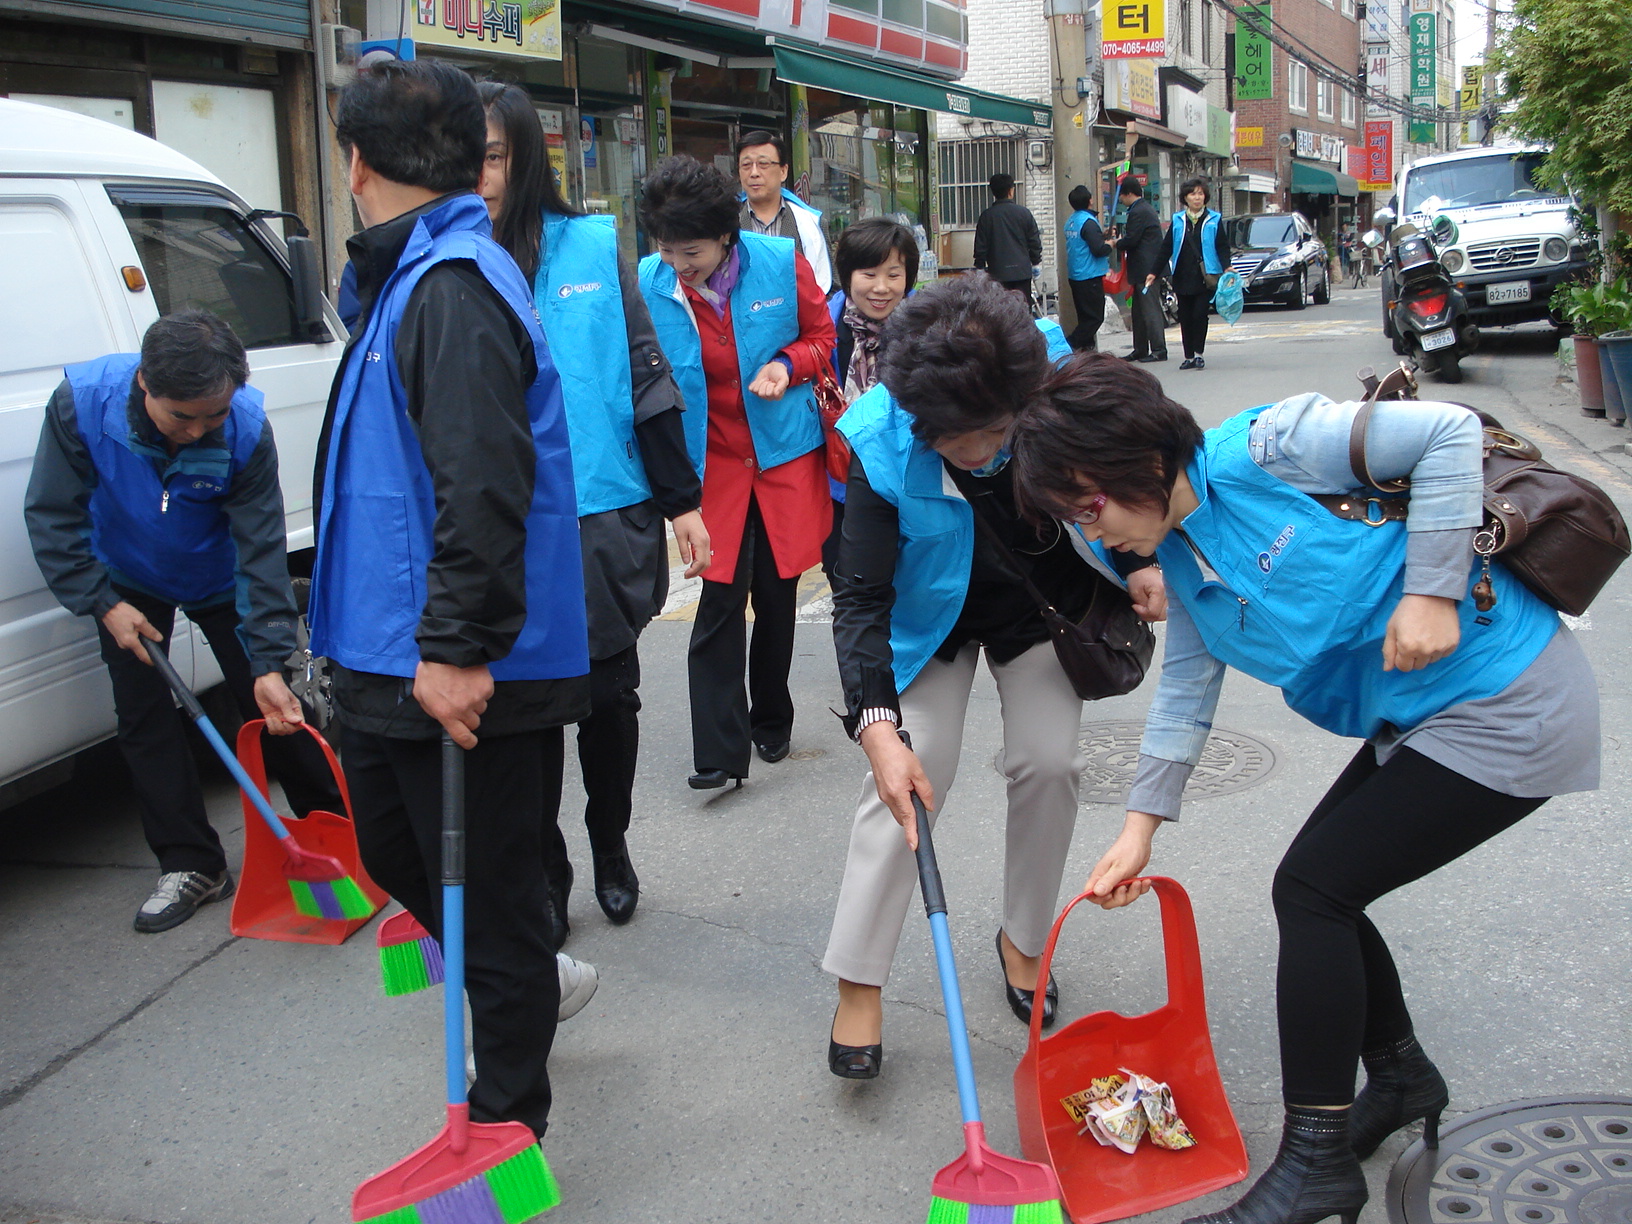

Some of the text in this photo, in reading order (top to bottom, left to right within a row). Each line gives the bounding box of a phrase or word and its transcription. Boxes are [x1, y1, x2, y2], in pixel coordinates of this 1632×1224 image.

[443, 0, 522, 46] 미니수퍼
[1118, 4, 1149, 33] 터
[1103, 41, 1164, 55] 070-4065-4499
[1245, 43, 1262, 75] 헤어
[1370, 135, 1387, 181] 페인트
[1270, 524, 1296, 556] 광진구
